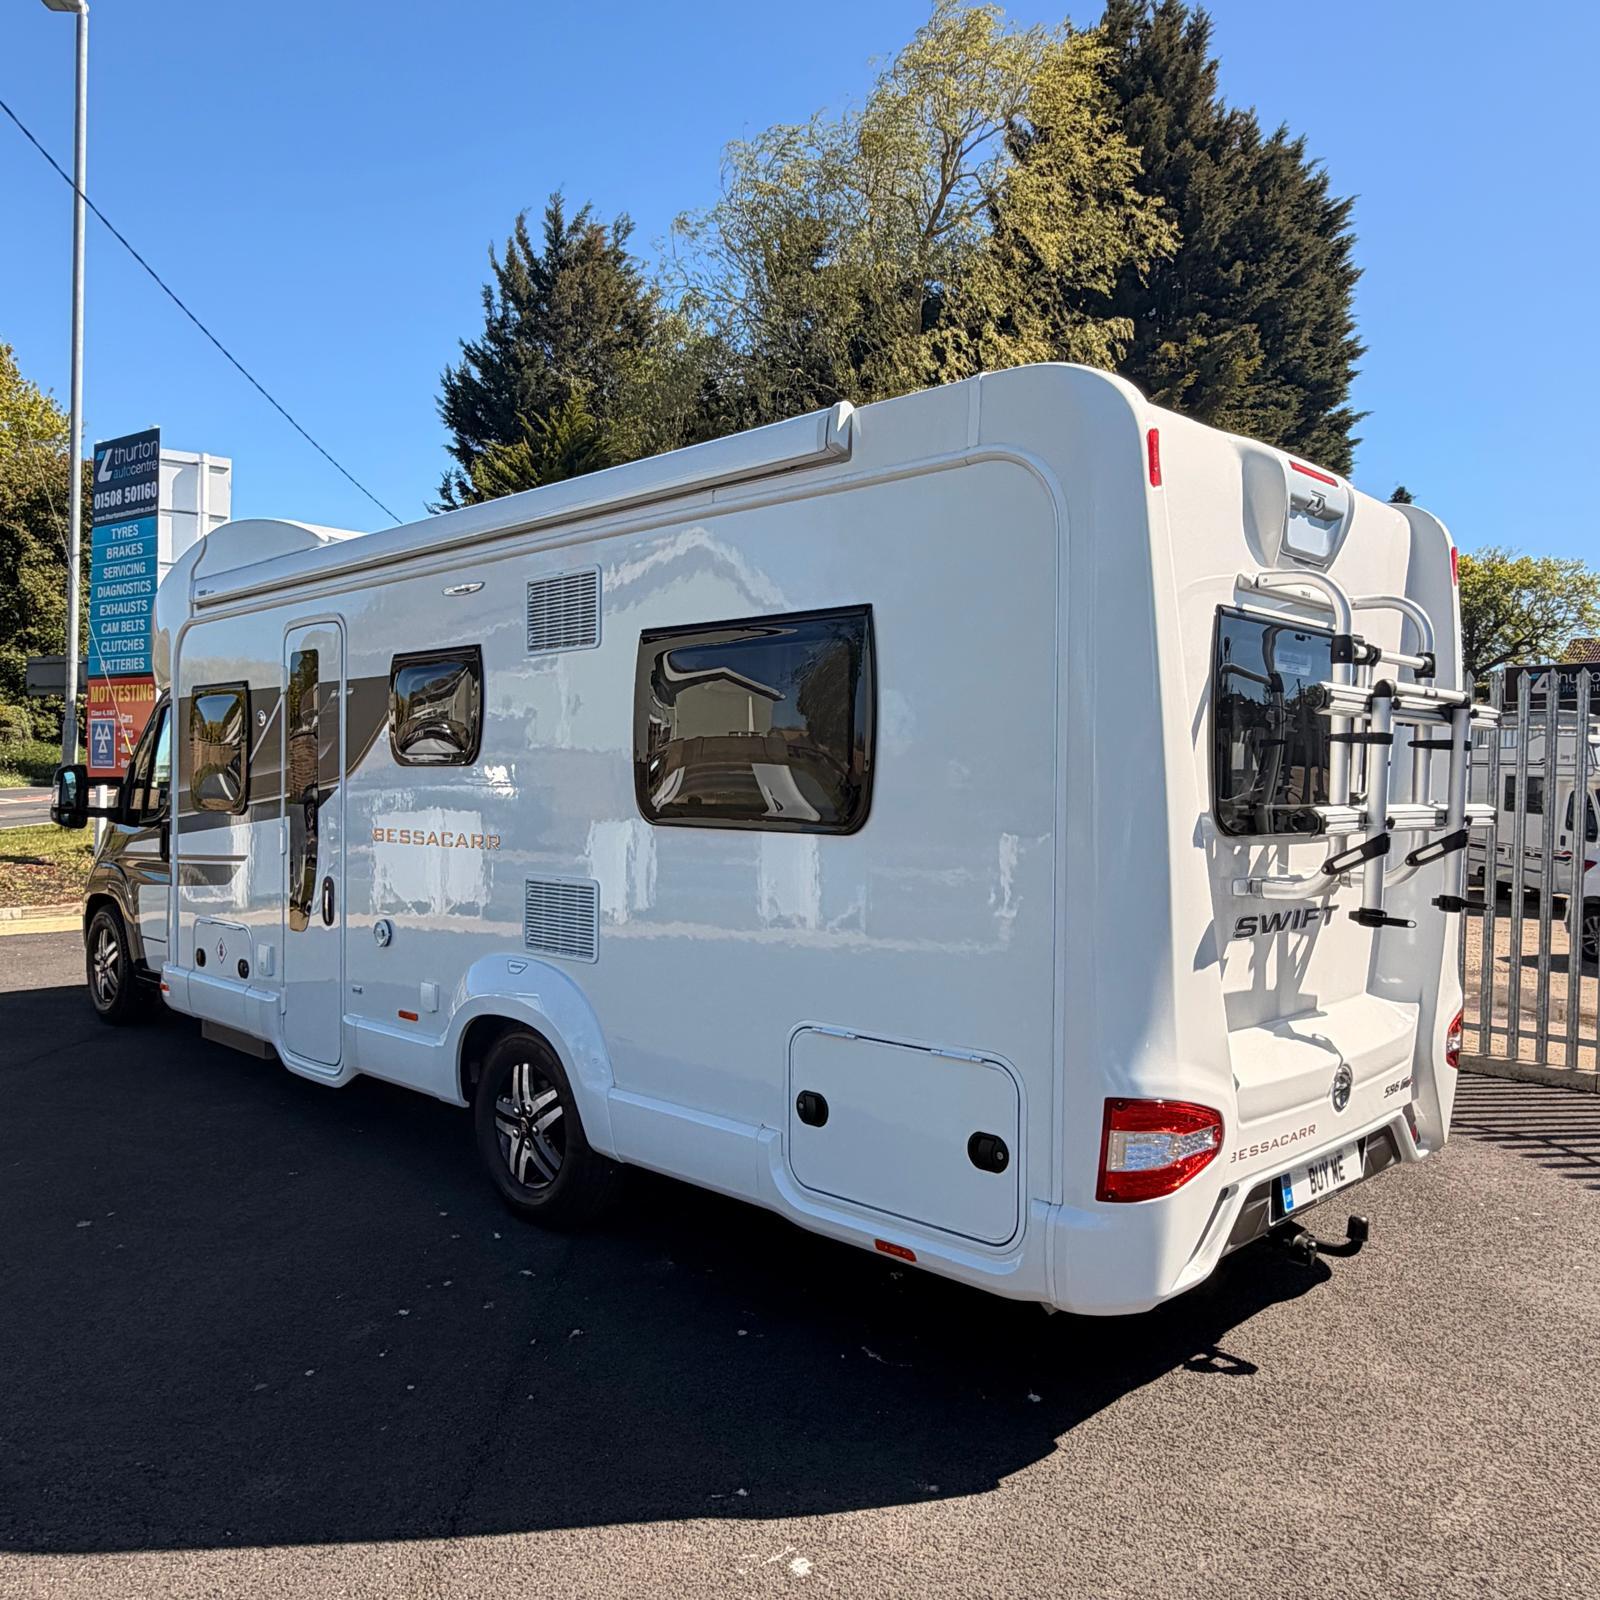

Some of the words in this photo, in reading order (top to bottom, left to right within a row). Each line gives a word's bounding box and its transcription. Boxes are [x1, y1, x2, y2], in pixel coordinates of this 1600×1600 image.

[115, 440, 158, 465] thurton
[113, 460, 157, 479] autocentre
[94, 489, 122, 510] 01508
[124, 481, 157, 504] 501160
[111, 524, 139, 540] TYRES
[106, 542, 143, 560] BRAKES
[103, 561, 146, 579] SERVICING
[97, 580, 152, 598] DIAGNOSTICS
[100, 600, 148, 616] EXHAUSTS
[101, 621, 119, 634] CAM
[121, 619, 146, 633] BELTS
[101, 638, 145, 653] CLUTCHES
[100, 657, 145, 672] BATTERIES
[91, 686, 110, 703] MOT
[113, 684, 154, 702] TESTING
[372, 828, 501, 851] BESSACARR
[1233, 904, 1340, 939] SWIFT
[1308, 1160, 1329, 1195] BUY
[1330, 1154, 1346, 1185] ME
